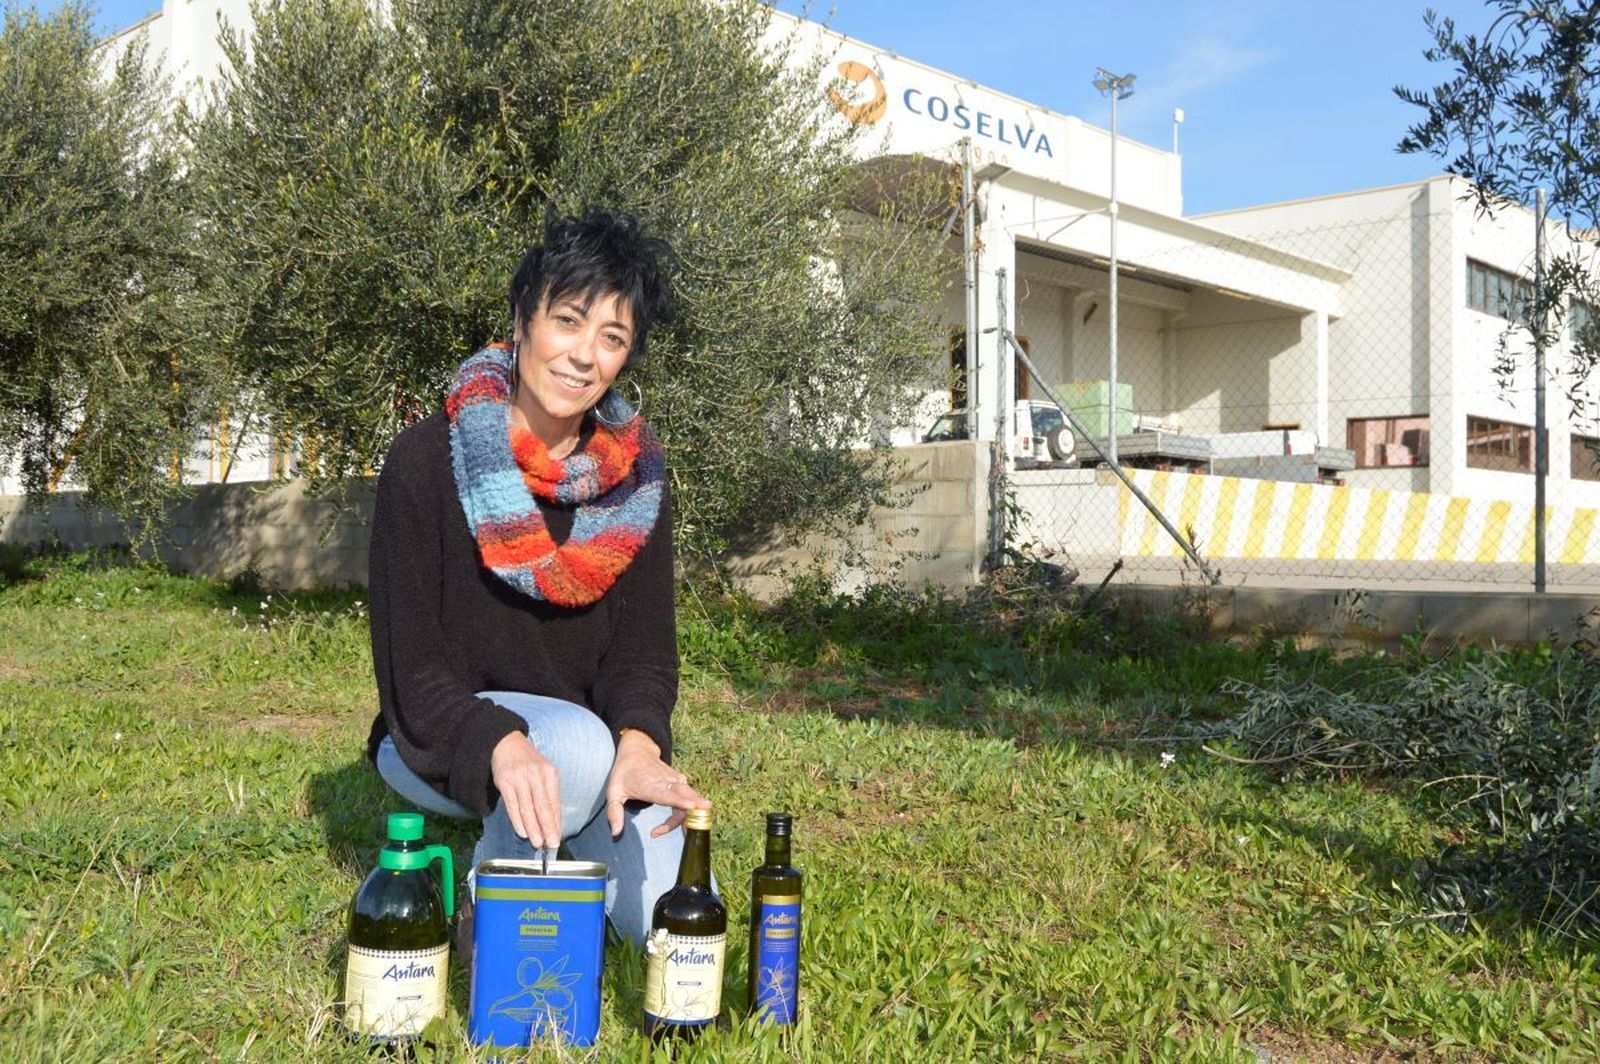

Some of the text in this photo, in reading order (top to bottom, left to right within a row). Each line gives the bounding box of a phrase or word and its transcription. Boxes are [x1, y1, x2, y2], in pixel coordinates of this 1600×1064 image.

[903, 88, 1053, 158] COSELVA
[517, 906, 561, 922] Antara
[666, 947, 715, 966] Antara
[382, 961, 435, 982] Antara
